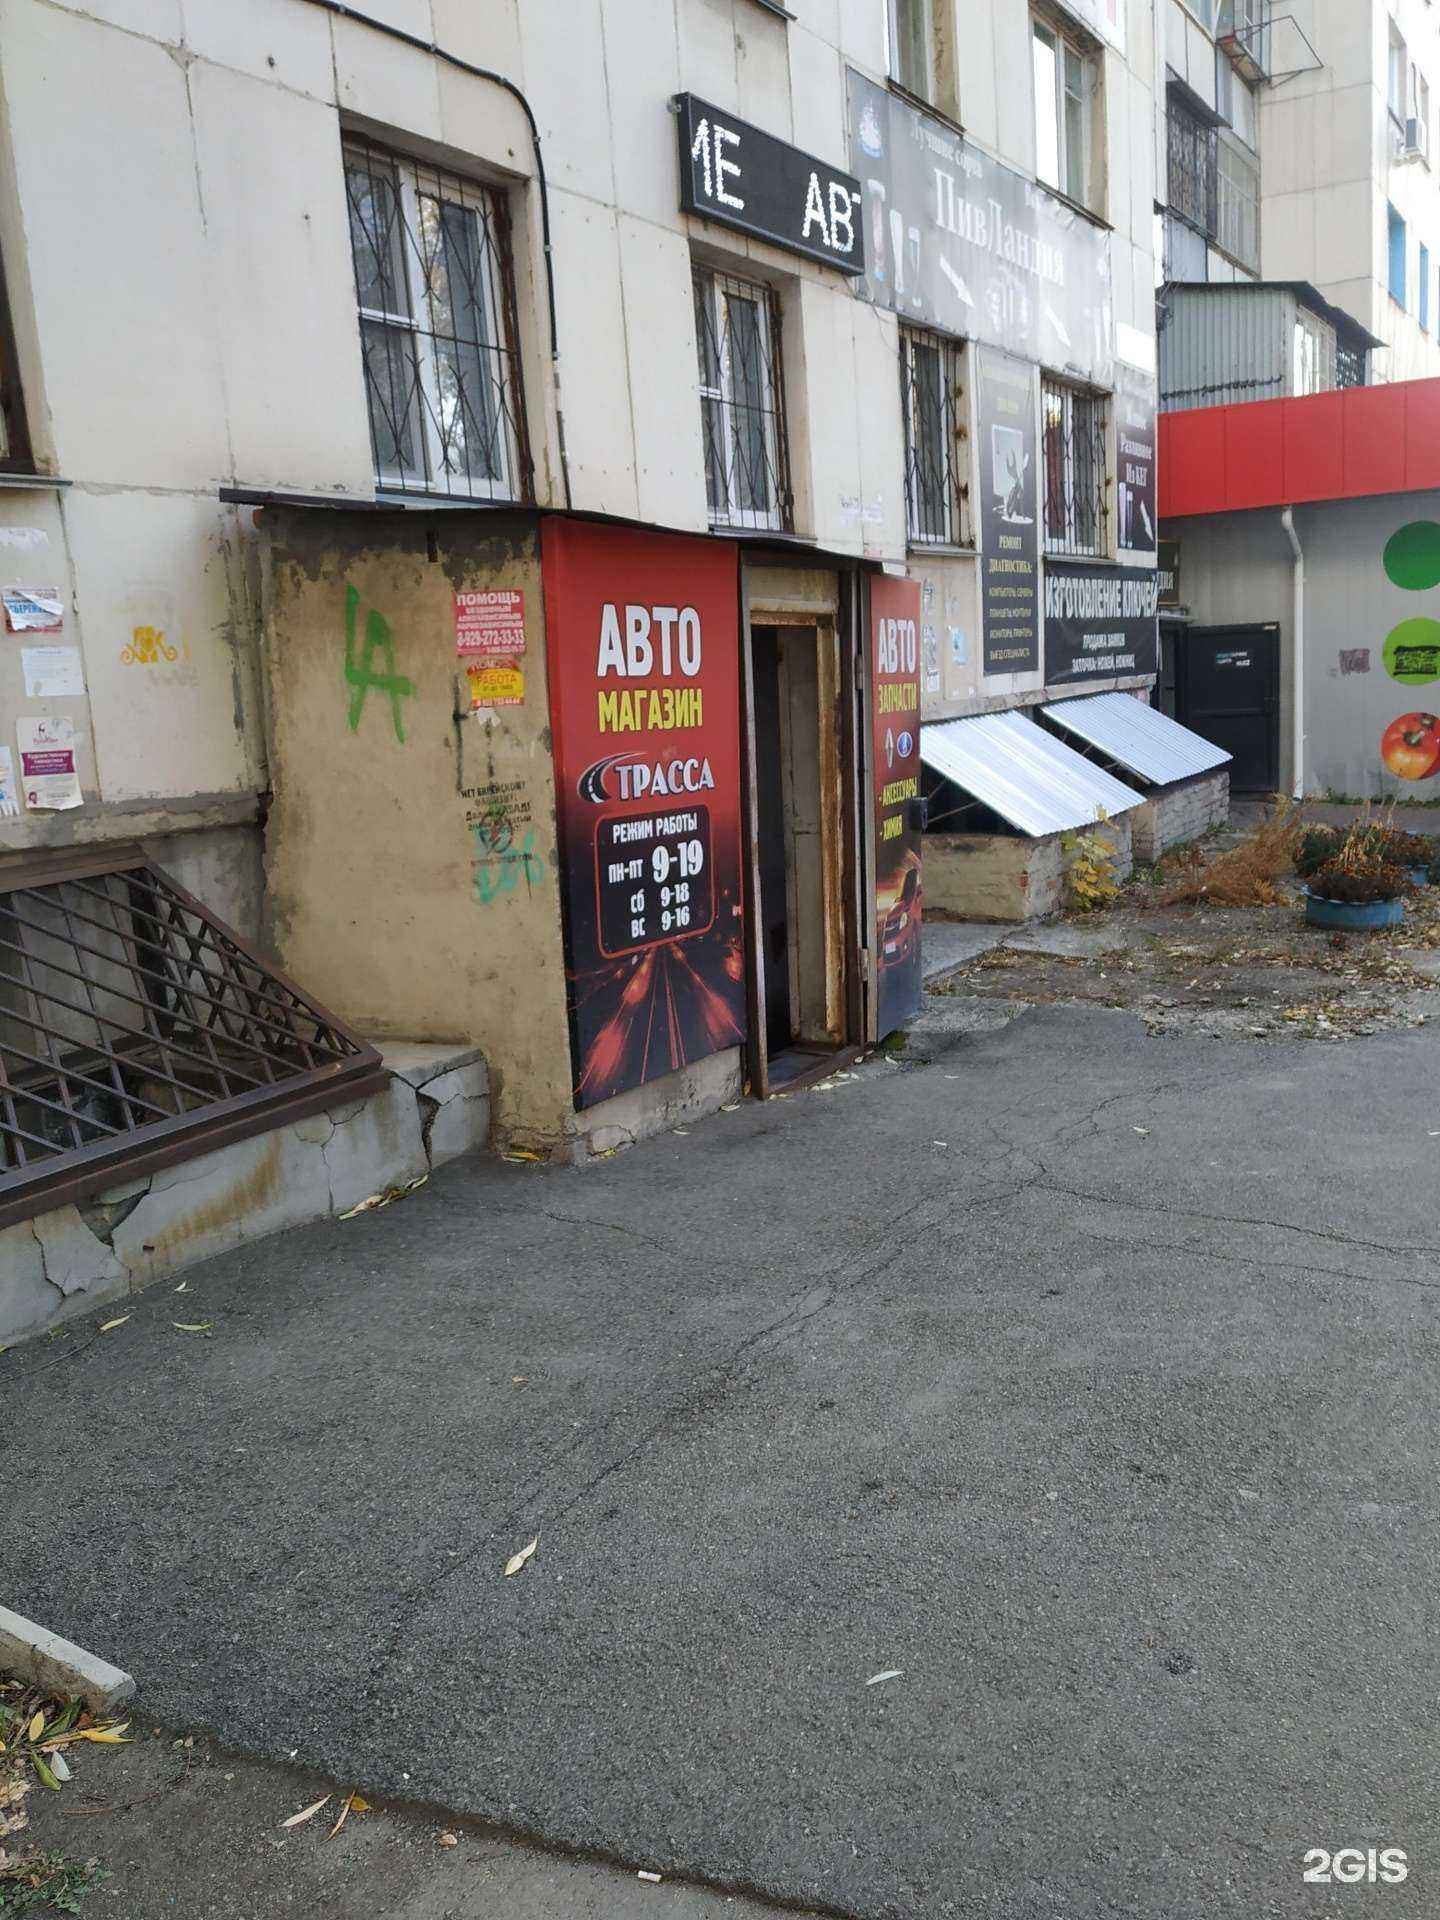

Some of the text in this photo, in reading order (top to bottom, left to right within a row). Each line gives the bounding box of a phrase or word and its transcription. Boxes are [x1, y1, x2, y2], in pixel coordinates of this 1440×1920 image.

[457, 592, 520, 606] ПОМОЩЬ
[1045, 575, 1158, 618] ИЗГОТОВЛЕНИЕ КЛЮЧЕЙ
[597, 604, 702, 677] АВТО
[878, 618, 916, 675] АВТО
[476, 673, 517, 685] РАБОТА
[598, 688, 703, 733] МАГАЗИН
[878, 683, 917, 714] ЗАПЧАСТИ
[615, 757, 715, 801] ТРАССА
[612, 812, 698, 844] РЕЖИМ РАБОТЫ
[608, 839, 704, 884] ПН-ПТ 9-19
[660, 883, 690, 907] 9-18
[660, 905, 690, 931] 9-16
